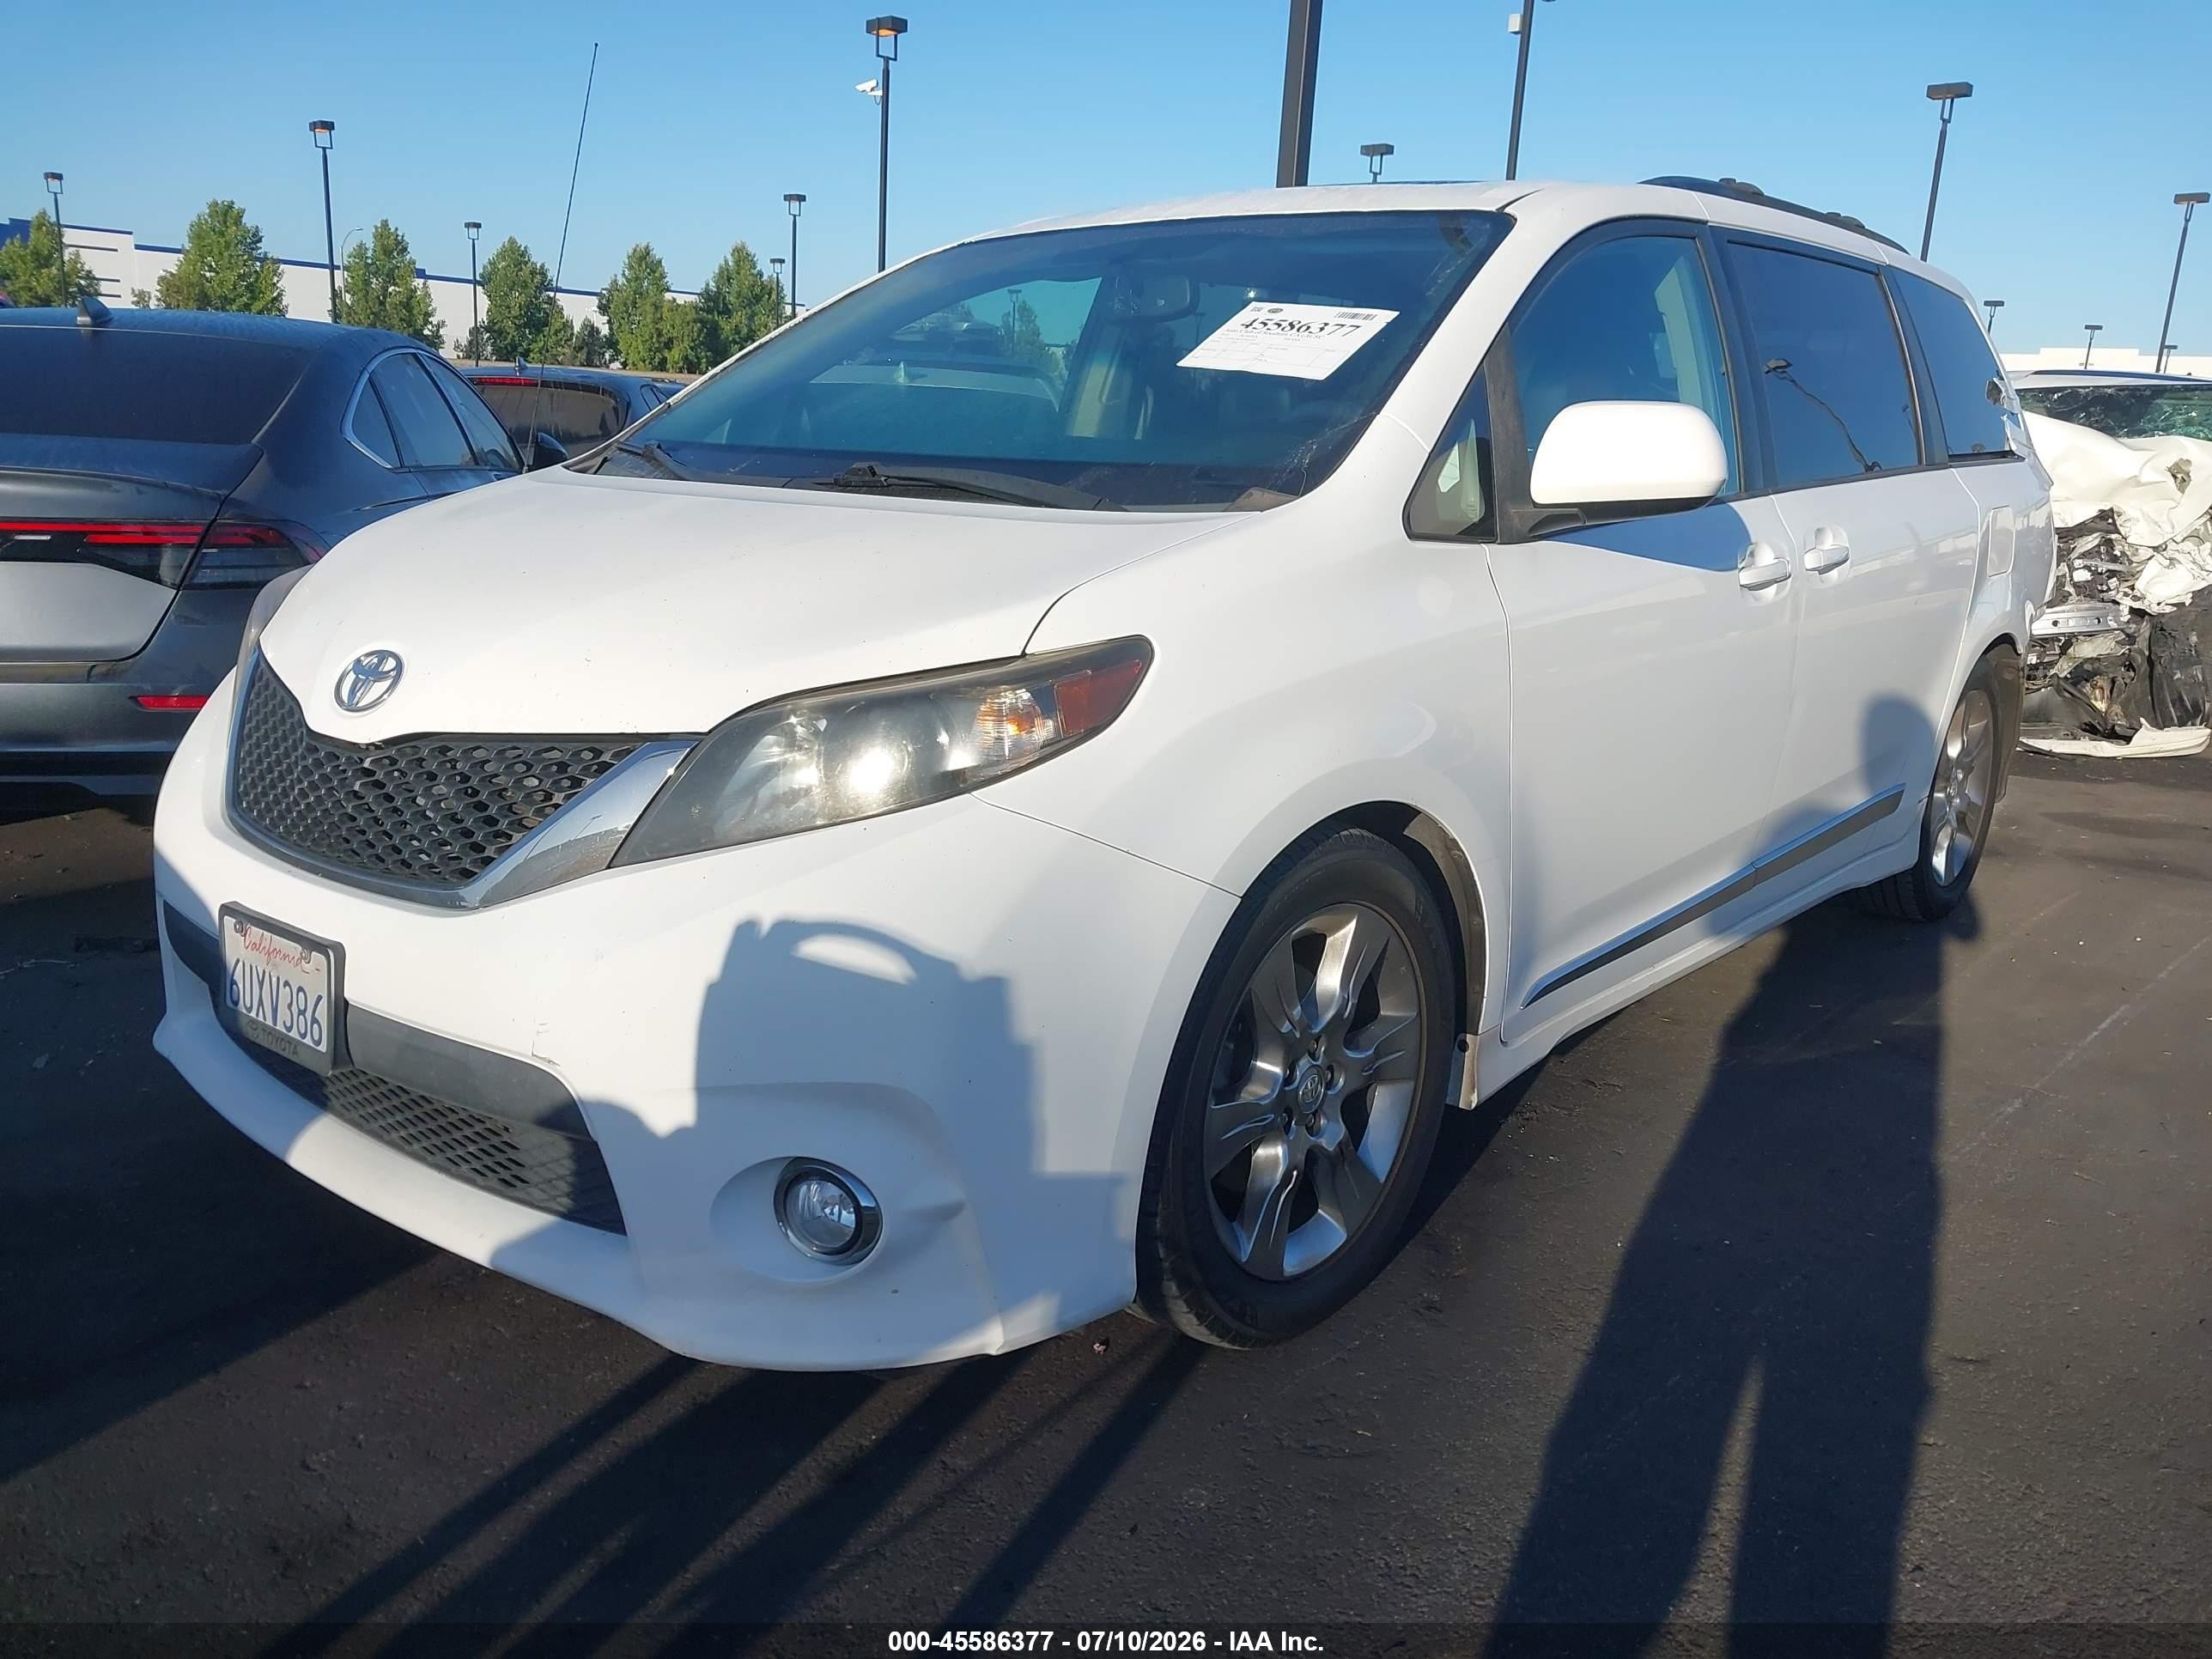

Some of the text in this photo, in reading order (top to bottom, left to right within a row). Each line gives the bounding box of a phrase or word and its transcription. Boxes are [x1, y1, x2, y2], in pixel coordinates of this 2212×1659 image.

[1240, 317, 1362, 337] 45586377
[243, 924, 310, 974] California
[229, 957, 324, 1048] 6UXV386
[261, 1028, 299, 1057] TOYOTA
